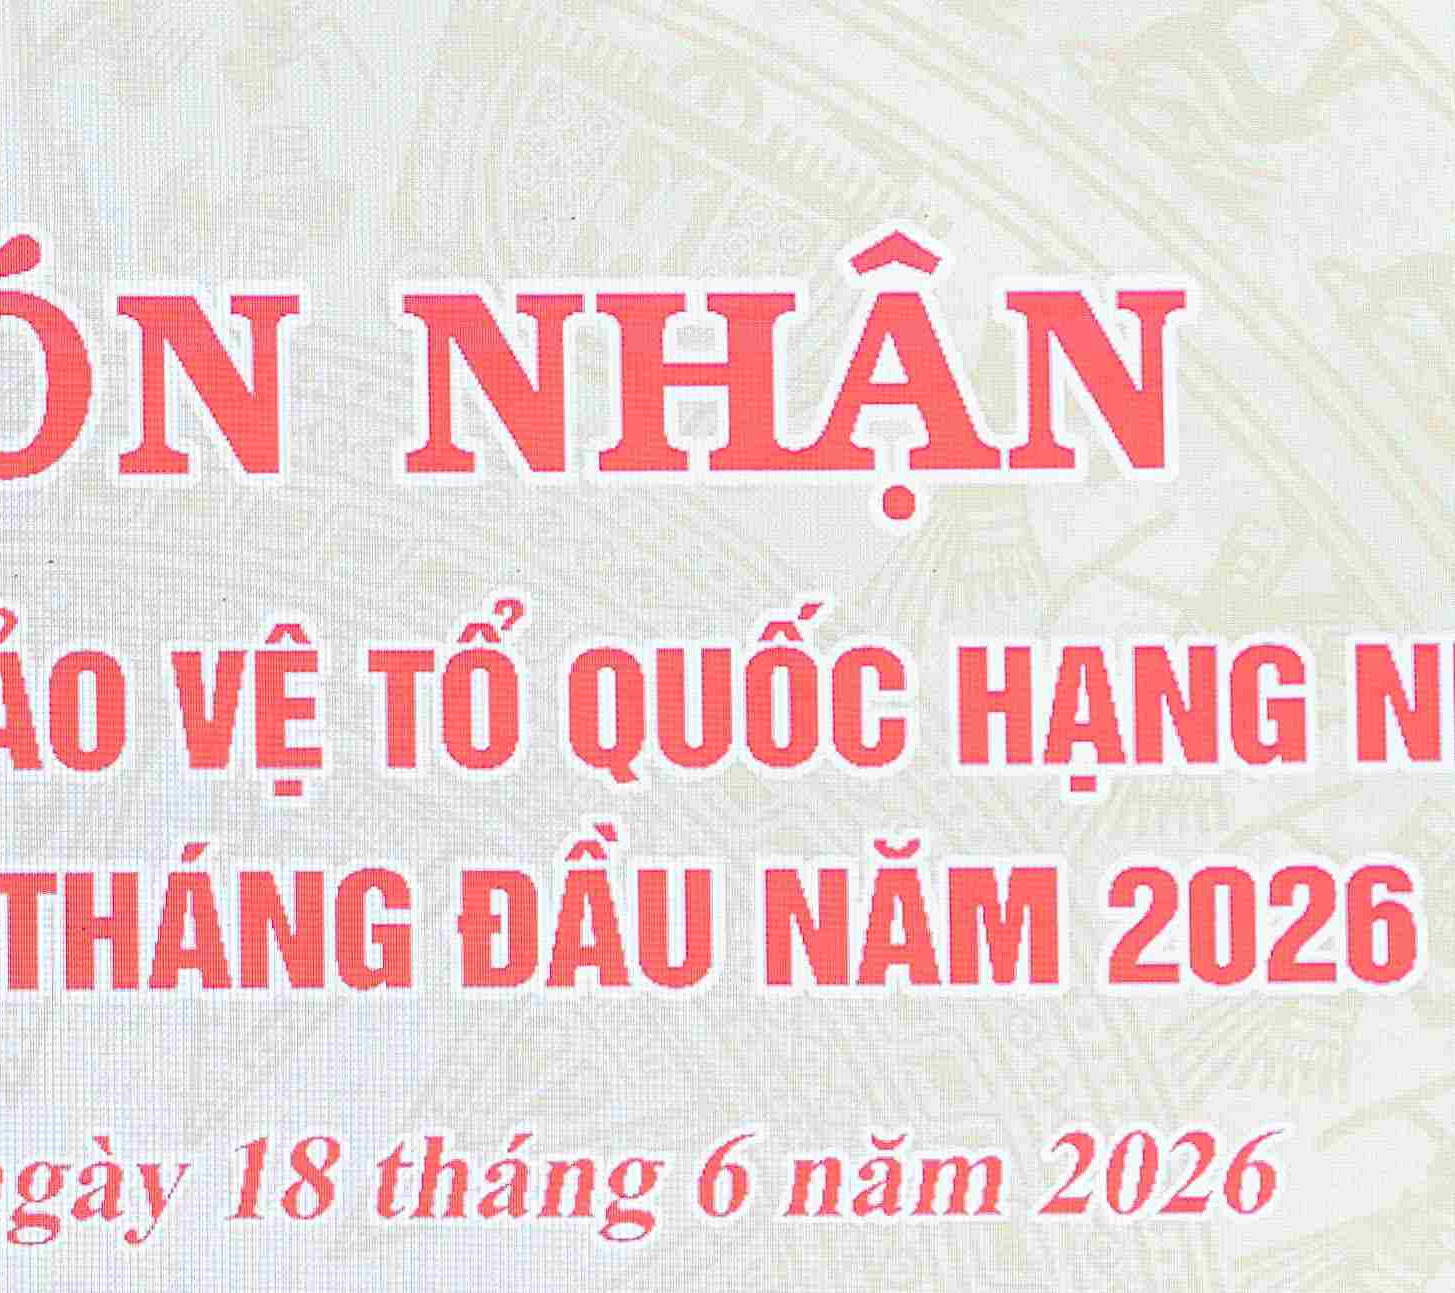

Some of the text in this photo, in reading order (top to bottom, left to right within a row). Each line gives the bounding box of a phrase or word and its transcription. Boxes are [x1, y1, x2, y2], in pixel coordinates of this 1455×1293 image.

[402, 229, 1188, 522] NHẬN
[170, 622, 324, 798] VỆ
[366, 597, 525, 771] TỔ
[567, 601, 908, 785] QUỐC
[956, 643, 1309, 796] HẠNG
[455, 823, 713, 990] ĐẦU
[763, 837, 1061, 988] NĂM
[1106, 863, 1418, 988] 2026
[236, 1135, 341, 1221] 18
[375, 1133, 659, 1241] tháng
[697, 1134, 750, 1218] 6
[786, 1134, 1003, 1218] năm
[1041, 1129, 1279, 1215] 2026
